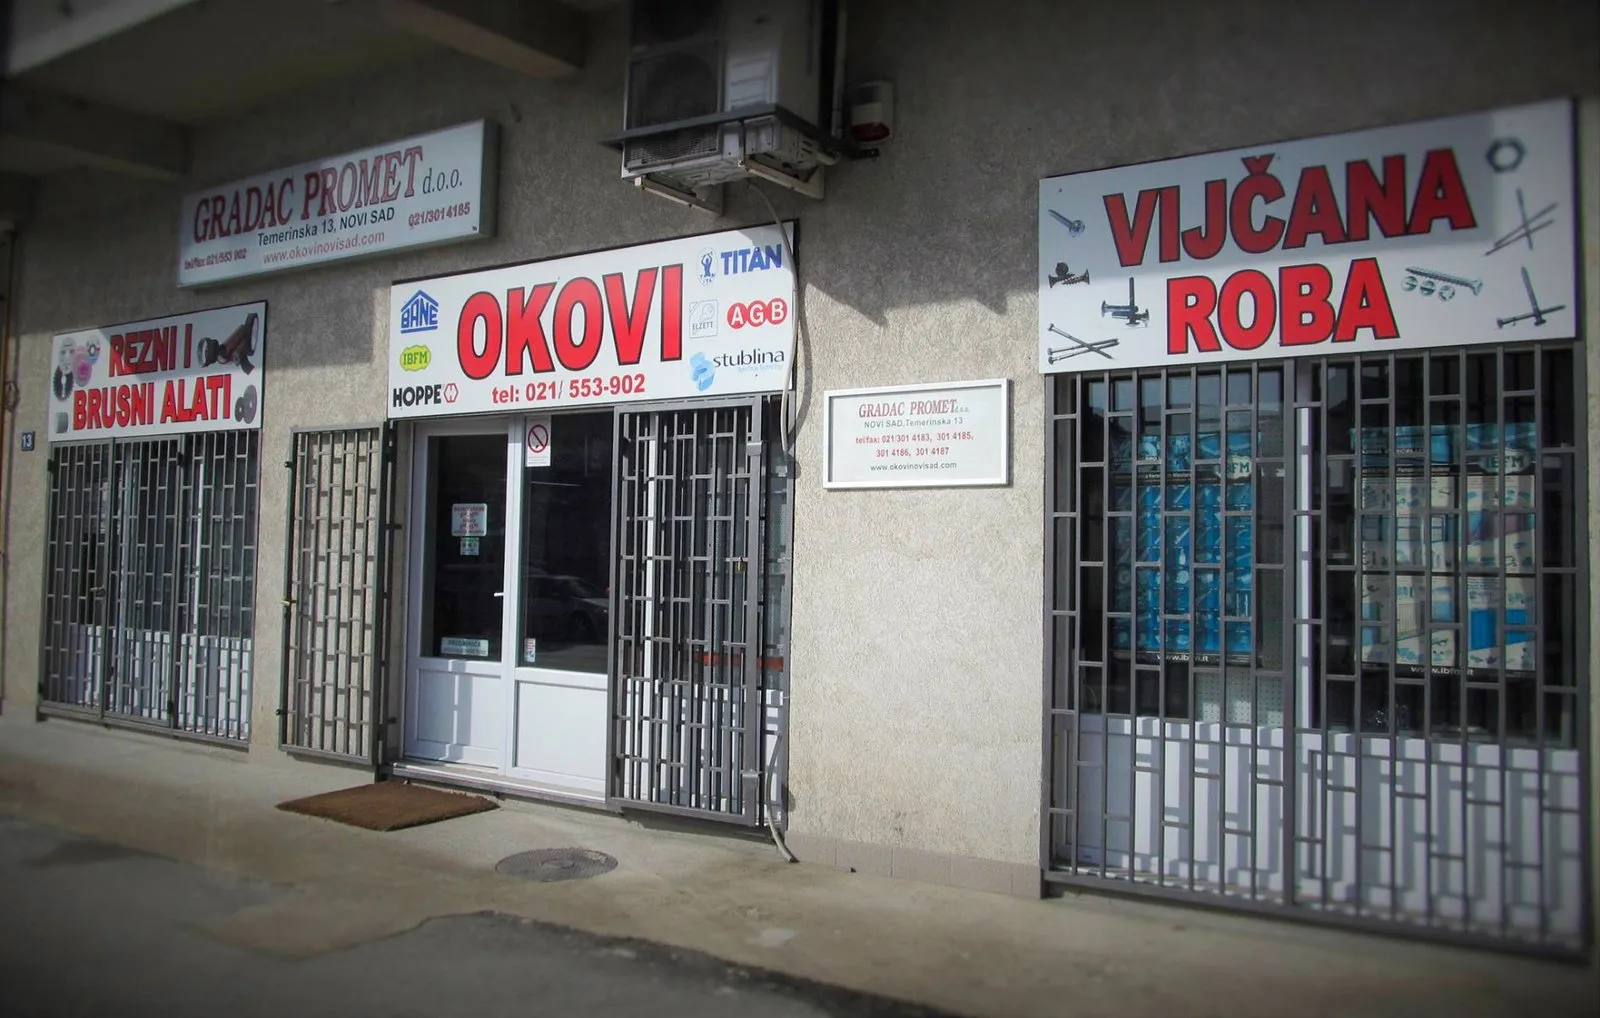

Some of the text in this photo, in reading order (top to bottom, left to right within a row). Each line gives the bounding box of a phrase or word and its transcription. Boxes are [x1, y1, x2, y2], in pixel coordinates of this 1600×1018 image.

[194, 146, 463, 244] GRADAC PROMET d.o.o.
[1102, 148, 1479, 268] VIJČANA
[257, 206, 395, 247] Temerinska 13, NOVI SAD
[263, 232, 385, 264] www.okovinovisad.com
[720, 243, 782, 275] TITAN
[401, 297, 438, 328] BANE
[730, 300, 785, 326] AGB
[1166, 256, 1400, 356] ROBA
[456, 263, 684, 381] OKOVI
[109, 323, 193, 378] REZNI I
[403, 351, 428, 366] IBFM
[712, 348, 785, 368] stublina
[73, 373, 232, 430] BRUSNI ALATI
[393, 384, 442, 408] HOPPE
[492, 373, 645, 404] tel: 021/ 553-902
[859, 402, 905, 418] GRADAC
[910, 399, 956, 415] PROMET
[864, 420, 883, 429] NOVI
[954, 417, 964, 425] 13
[22, 434, 32, 448] 13
[876, 449, 888, 458] 301
[916, 447, 928, 456] 301
[931, 446, 950, 455] 4187
[937, 432, 950, 441] 301
[870, 461, 957, 471] www.okovinovisad.com
